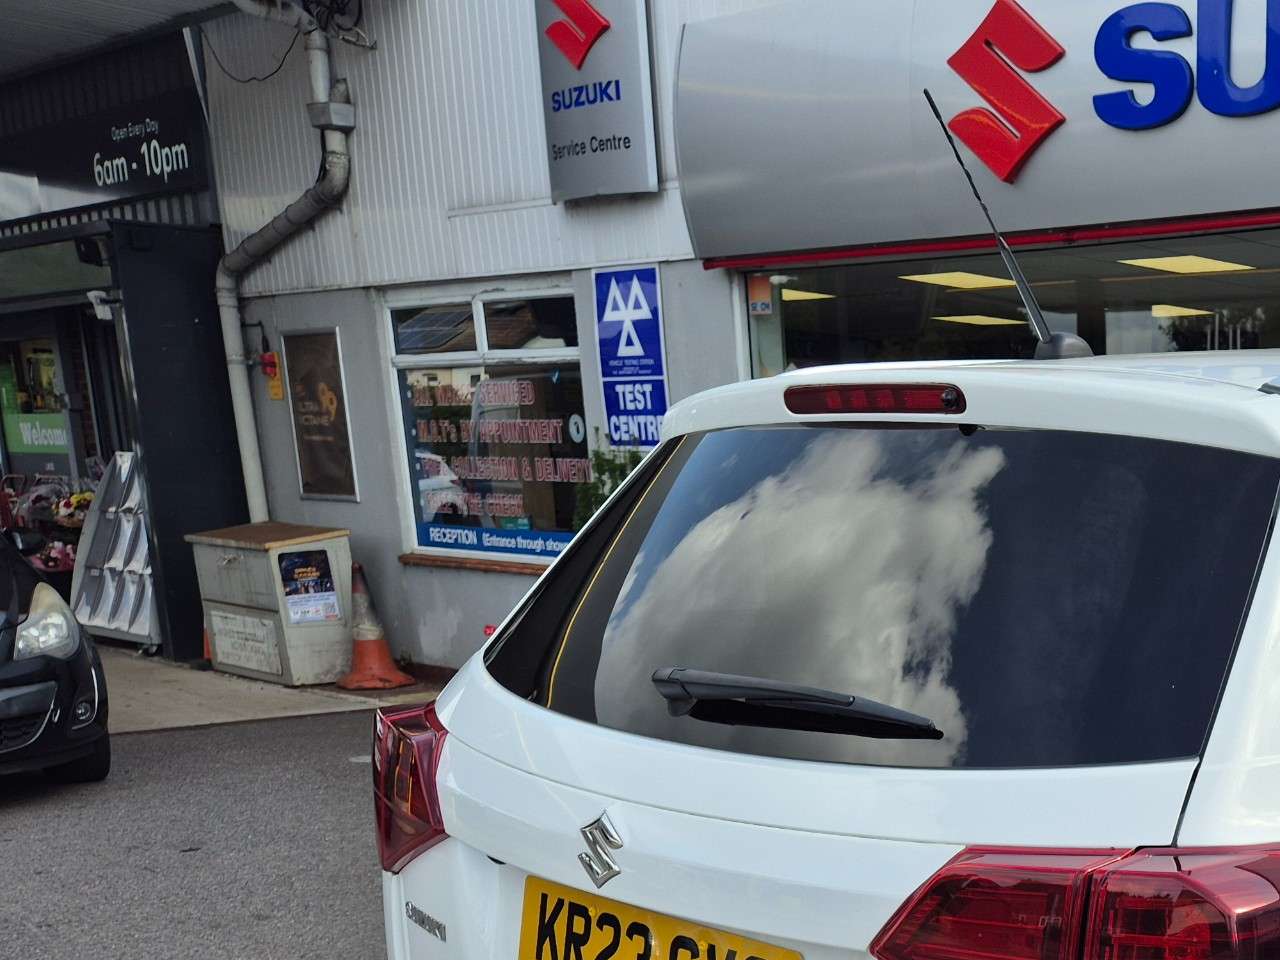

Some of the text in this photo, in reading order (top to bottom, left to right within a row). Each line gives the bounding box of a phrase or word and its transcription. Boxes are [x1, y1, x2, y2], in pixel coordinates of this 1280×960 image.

[551, 80, 622, 112] SUZUKI
[552, 134, 631, 161] Service Centre
[94, 152, 128, 187] 6am
[141, 139, 189, 184] 10pm
[615, 383, 653, 410] TEST
[479, 419, 563, 443] APPOINTMENT
[534, 457, 592, 483] DELIVERY
[429, 527, 477, 545] RECEPTION
[517, 536, 545, 552] through
